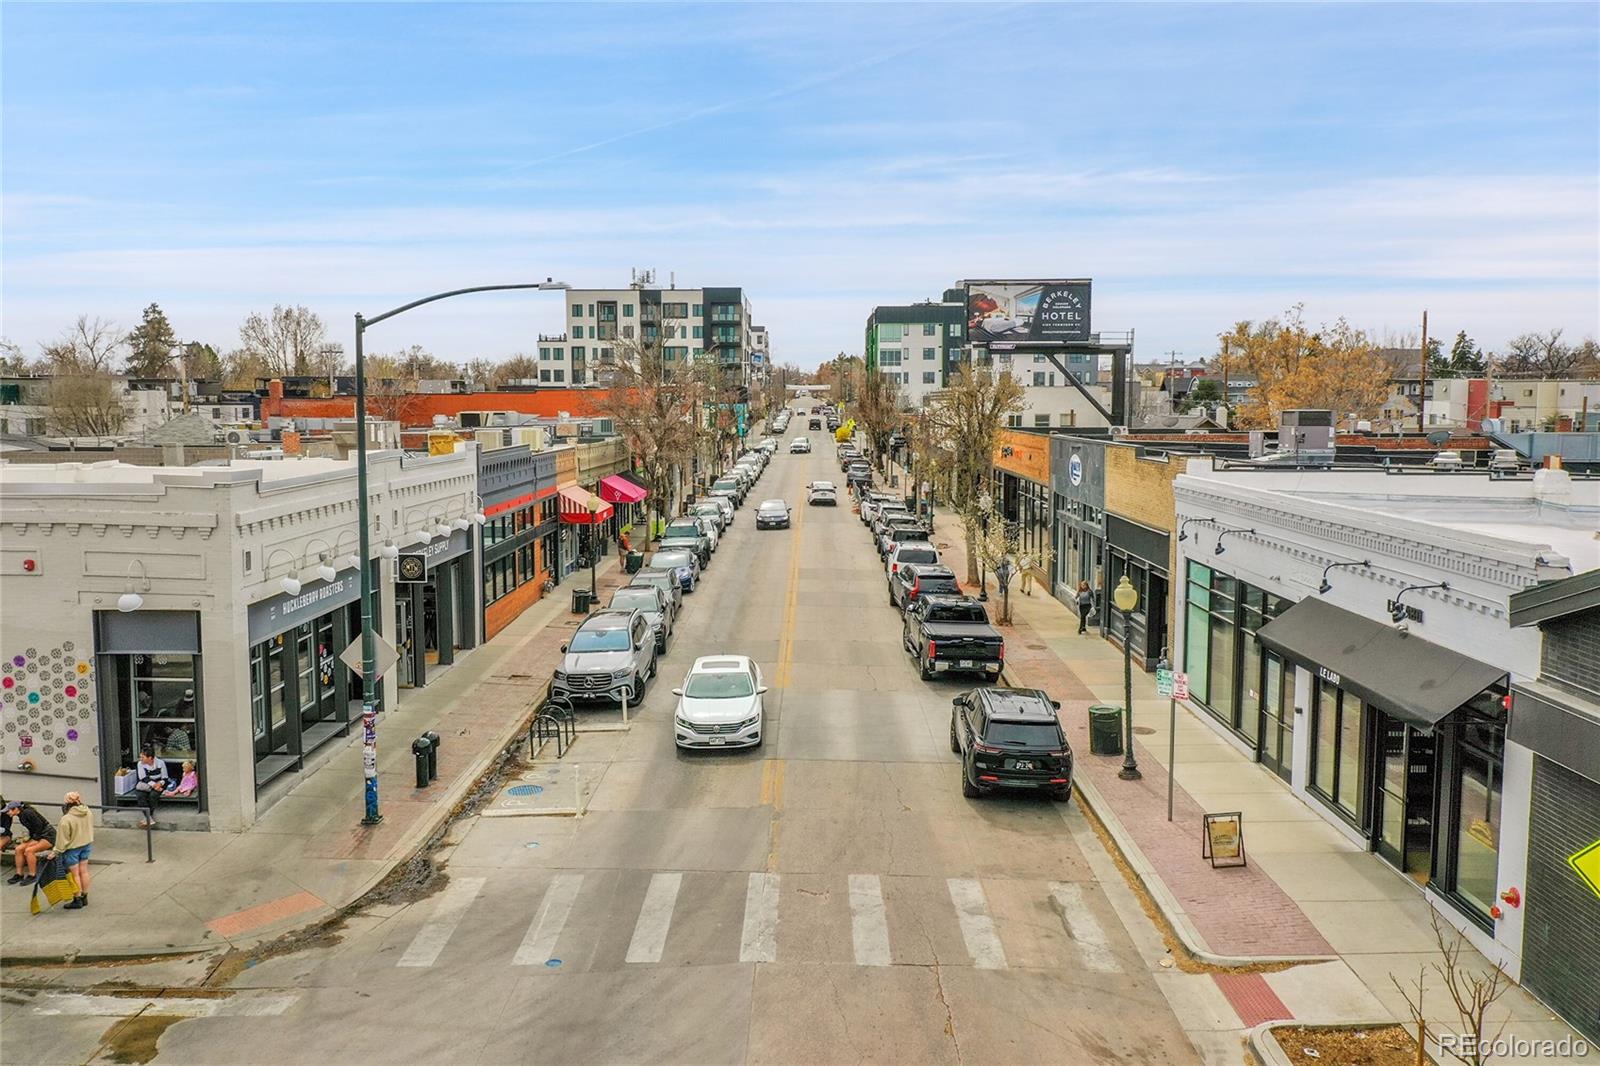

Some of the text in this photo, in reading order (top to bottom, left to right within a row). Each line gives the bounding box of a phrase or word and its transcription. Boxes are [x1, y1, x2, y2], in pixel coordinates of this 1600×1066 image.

[1042, 290, 1082, 309] BERKELEY
[1041, 312, 1082, 320] HOTEL
[434, 540, 449, 554] SUPPLY
[282, 589, 319, 615] HUCKLEBERRY
[319, 580, 344, 600] ROASTERS
[1320, 666, 1340, 685] LE LABO
